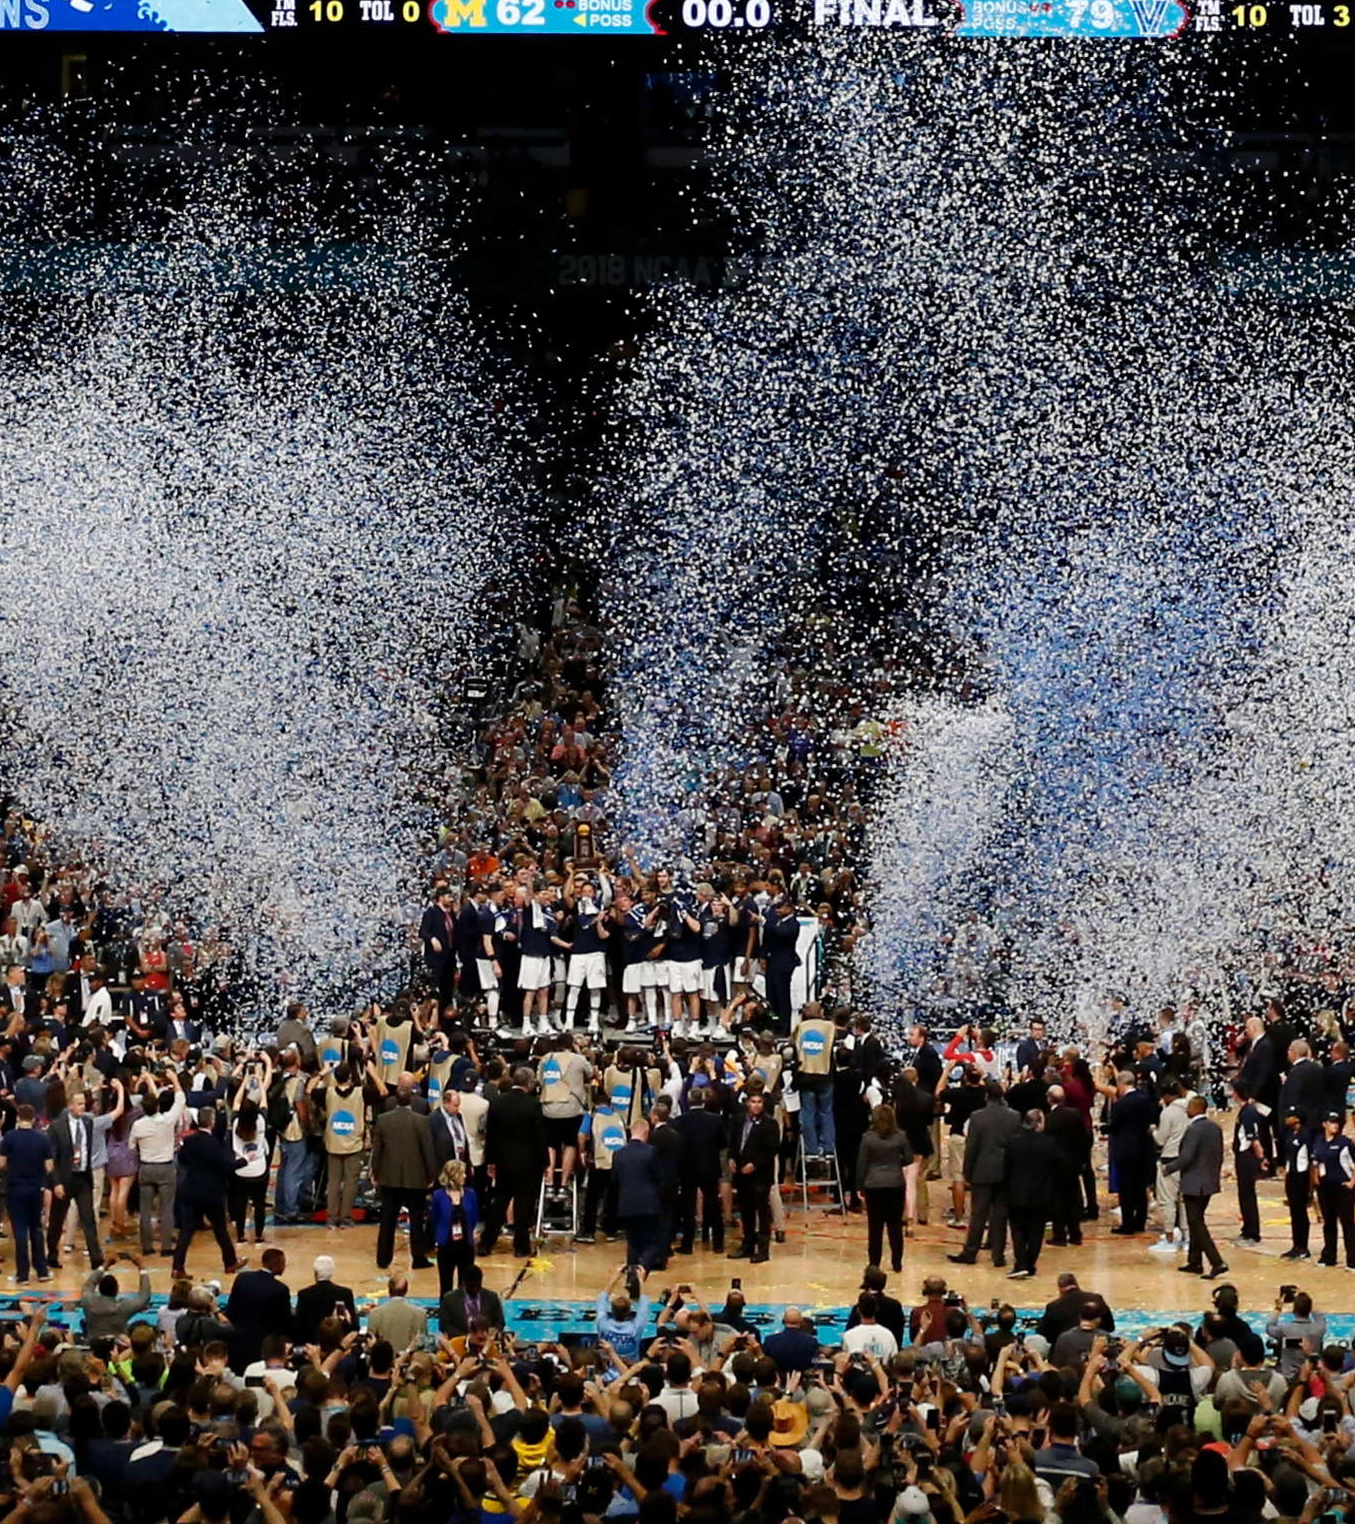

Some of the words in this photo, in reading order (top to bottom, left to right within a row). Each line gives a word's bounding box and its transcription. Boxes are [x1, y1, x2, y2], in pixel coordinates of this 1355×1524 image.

[271, 10, 298, 28] FLS.
[309, 0, 344, 22] 10
[360, 0, 394, 22] TOL
[402, 1, 421, 22] 0
[589, 13, 633, 28] POSS
[1196, 0, 1221, 15] TM
[1232, 6, 1267, 27] 10
[1290, 5, 1326, 26] TOL
[1333, 5, 1351, 27] 3
